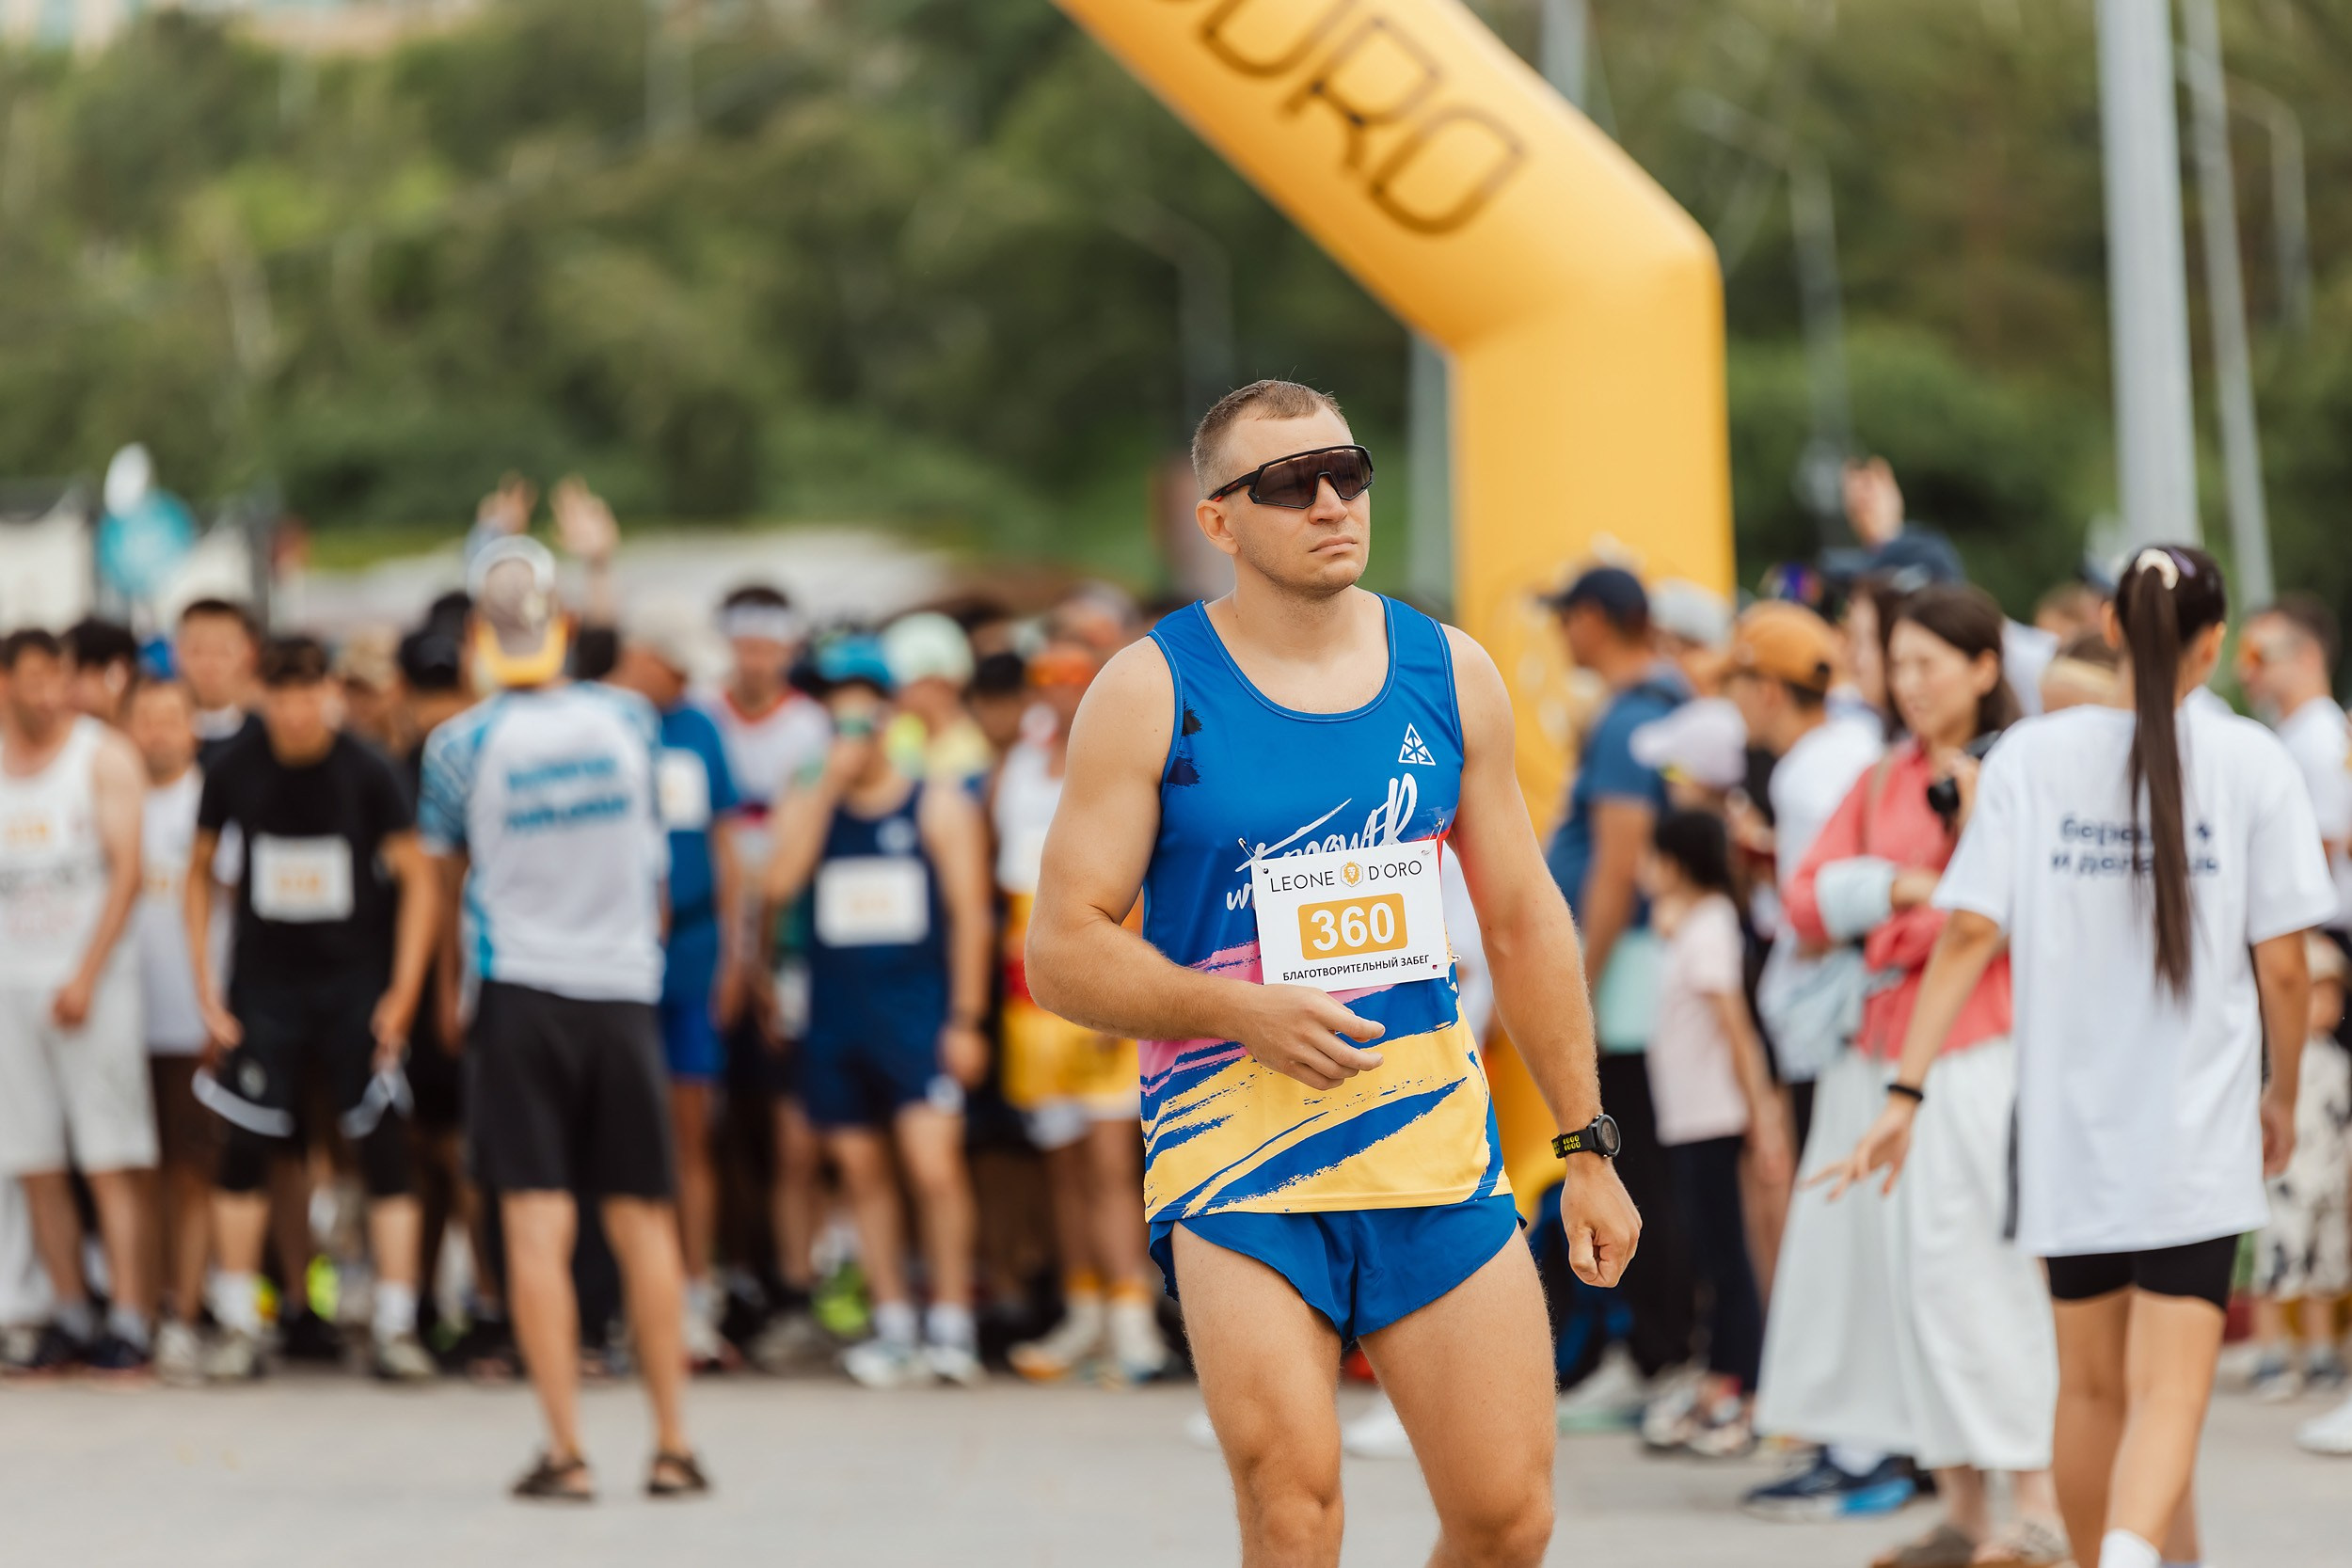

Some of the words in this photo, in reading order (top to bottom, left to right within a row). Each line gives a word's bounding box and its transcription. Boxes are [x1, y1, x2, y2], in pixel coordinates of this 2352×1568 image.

[1270, 870, 1335, 893] LEONE
[1368, 860, 1422, 880] D'ORO
[1311, 902, 1395, 951] 360
[1282, 956, 1399, 981] БЛАГОТВОРИТЕЛЬНЫЙ
[1401, 954, 1430, 966] ЗАБЕГ
